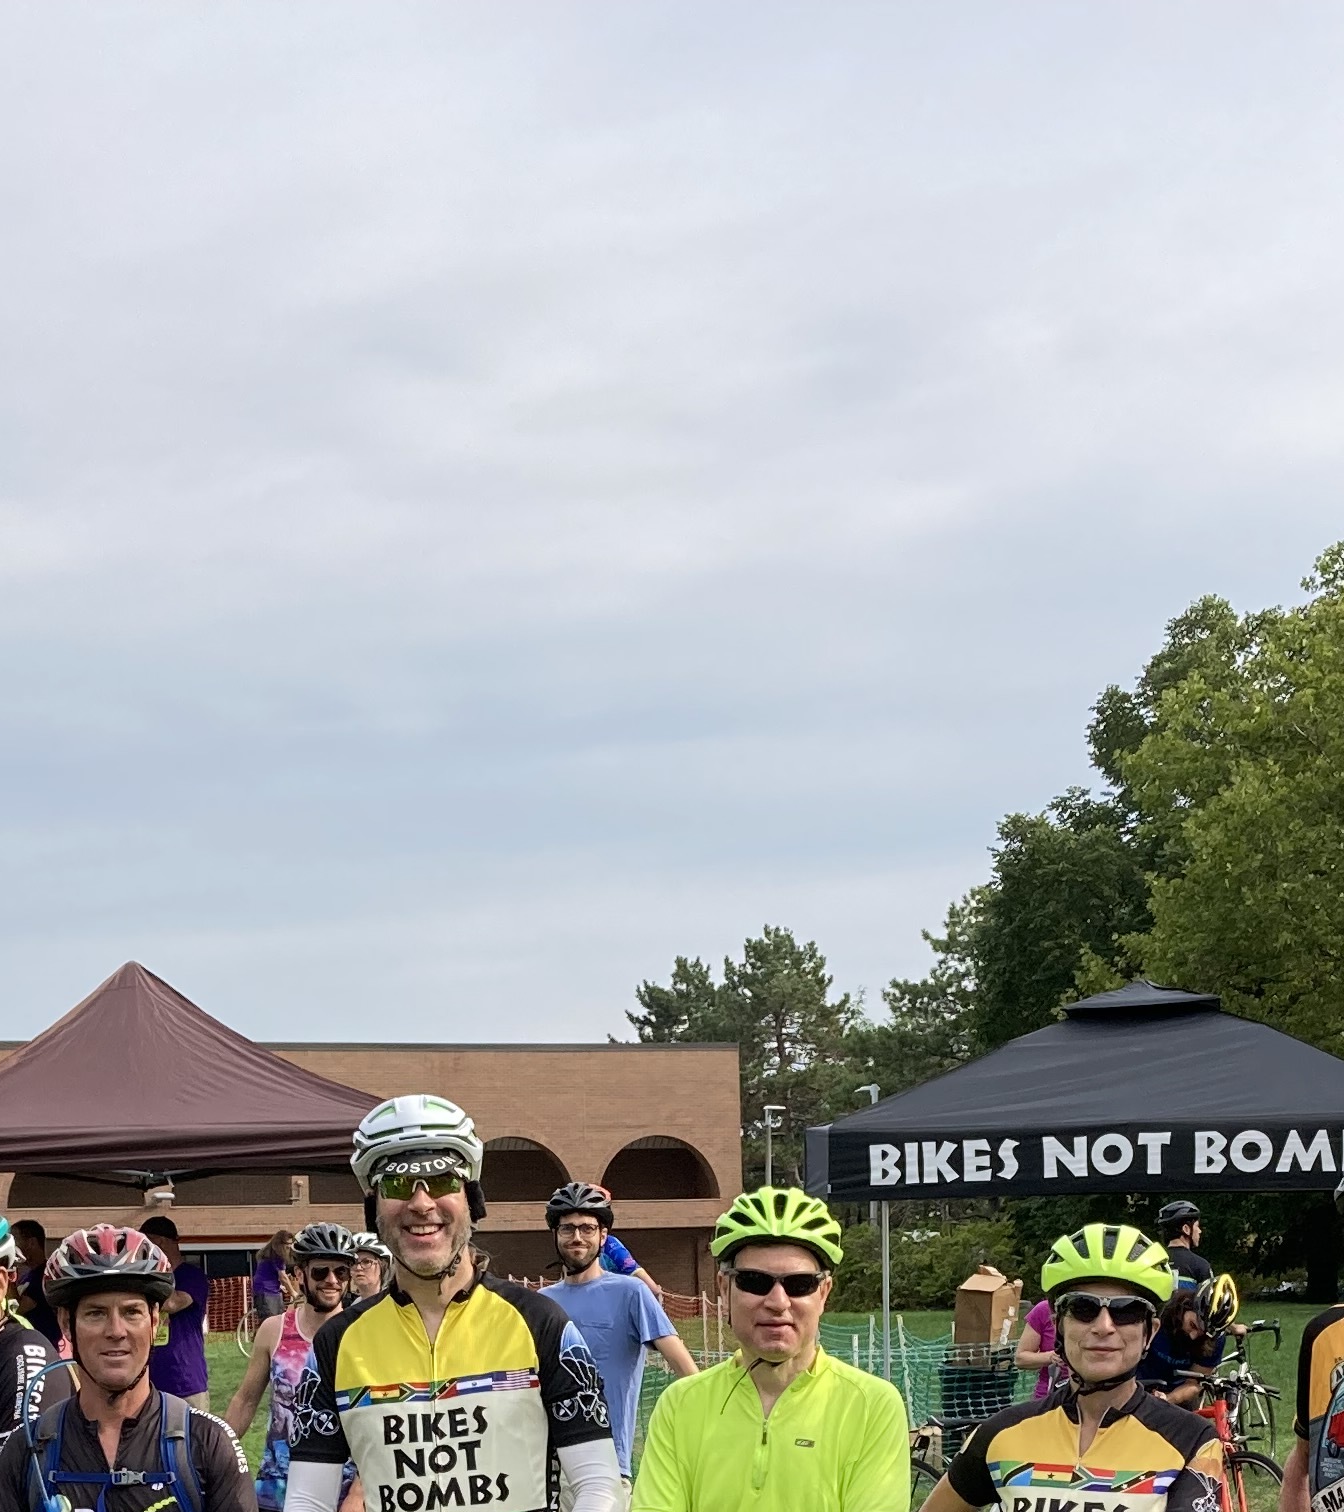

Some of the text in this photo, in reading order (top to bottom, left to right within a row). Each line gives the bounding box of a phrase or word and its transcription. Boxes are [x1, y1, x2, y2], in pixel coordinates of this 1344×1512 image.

[385, 1156, 456, 1173] BOSTON
[869, 1138, 1019, 1186] BIKES
[1043, 1131, 1171, 1178] NOT
[189, 1407, 249, 1474] HANGING LIVES
[383, 1405, 487, 1445] BIKES
[393, 1439, 481, 1479] NOT
